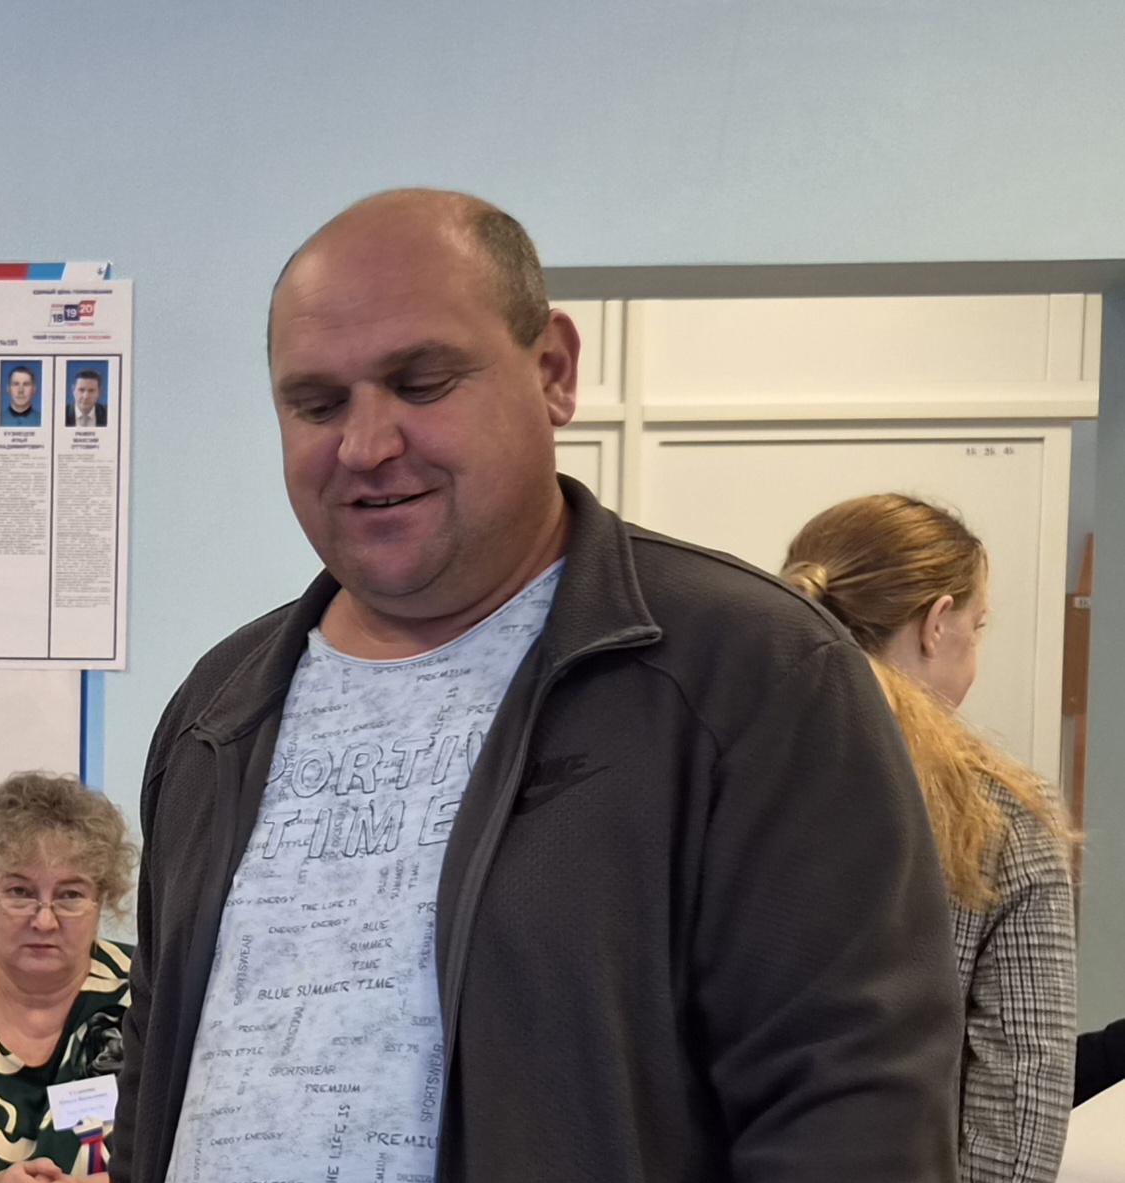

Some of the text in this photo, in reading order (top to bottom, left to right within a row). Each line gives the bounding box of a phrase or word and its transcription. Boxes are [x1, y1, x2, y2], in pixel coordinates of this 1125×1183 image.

[65, 308, 77, 318] 19
[79, 304, 93, 313] 20
[52, 314, 64, 323] 18
[262, 795, 463, 859] TIME
[257, 976, 396, 1001] BLUE SUMMER TIME
[268, 1064, 337, 1077] SPORTSWEAR
[304, 1083, 361, 1093] PREMIUM
[420, 1043, 444, 1123] SPORTSWEAR
[337, 1103, 351, 1119] IS
[328, 1123, 348, 1160] LIFE
